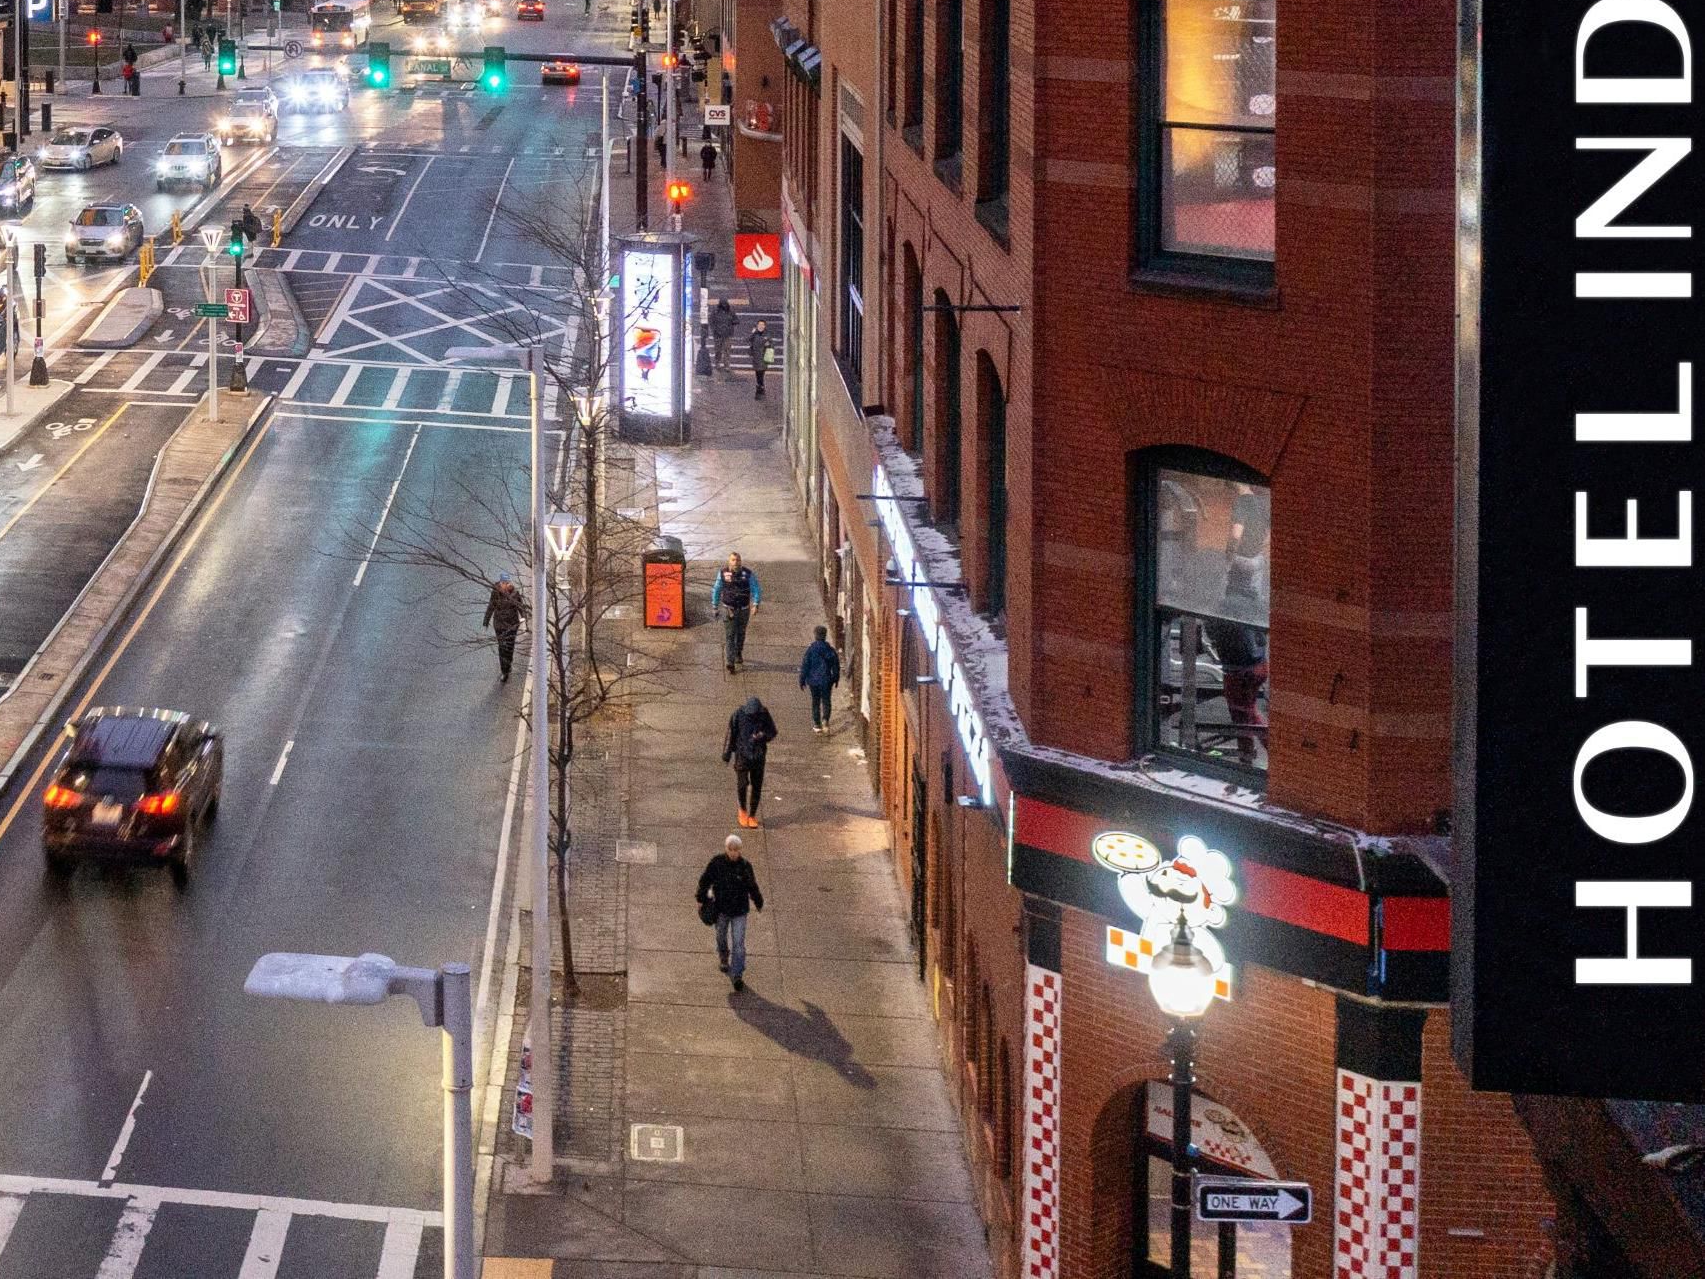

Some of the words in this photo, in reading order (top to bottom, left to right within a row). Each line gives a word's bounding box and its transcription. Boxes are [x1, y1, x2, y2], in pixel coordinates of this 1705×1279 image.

[709, 109, 726, 117] CVS
[309, 214, 384, 230] ONLY
[1573, 362, 1694, 983] HOTEL
[1211, 1197, 1239, 1209] ONE
[1249, 1197, 1279, 1209] WAY
